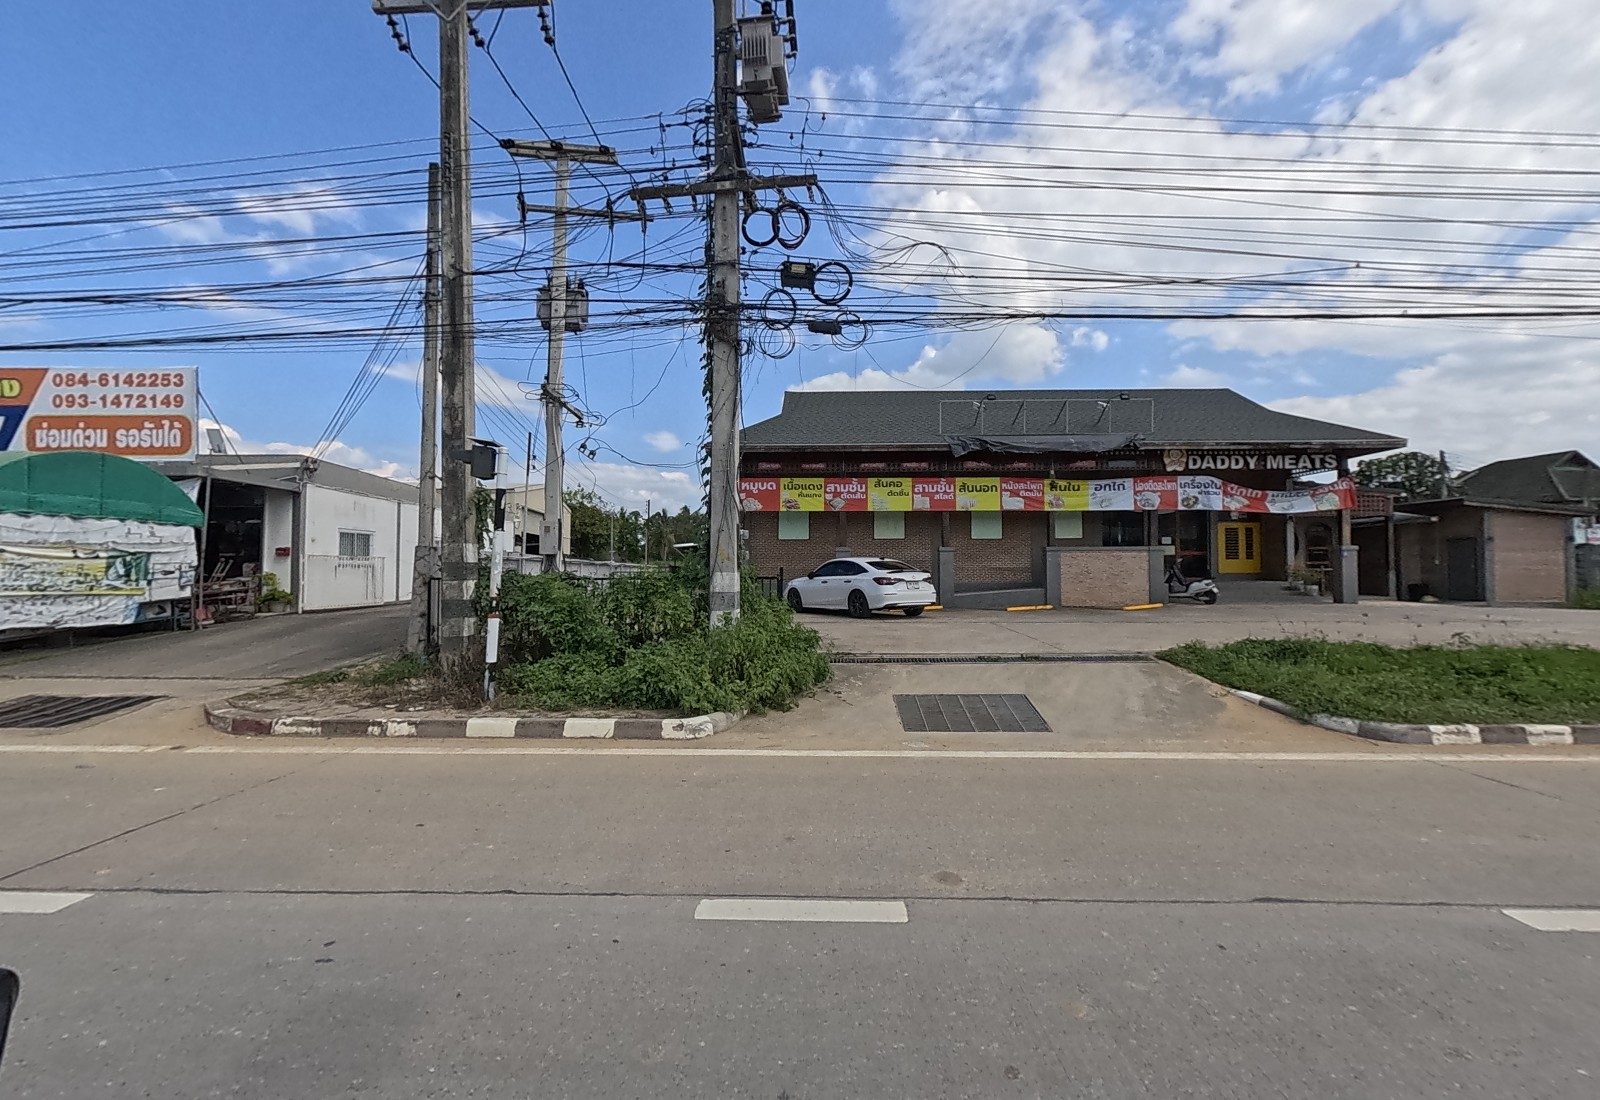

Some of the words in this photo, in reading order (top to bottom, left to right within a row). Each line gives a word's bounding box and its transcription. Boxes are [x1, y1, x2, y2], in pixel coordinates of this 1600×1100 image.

[52, 373, 184, 387] 084-6142253
[52, 393, 184, 408] 093-1472149
[35, 422, 108, 448] ซ่อมด่วน
[115, 420, 182, 448] รอรับได้
[1188, 455, 1257, 469] DADDY
[1266, 454, 1338, 469] MEATS
[741, 481, 777, 494] หมูบด
[783, 478, 823, 491] เนื้อแดง
[826, 477, 866, 493] สามชั้น
[874, 478, 903, 488] สันคอ
[914, 477, 955, 493] สามชั้น
[959, 481, 998, 493] สันนอก
[1094, 480, 1127, 492] อกไก่
